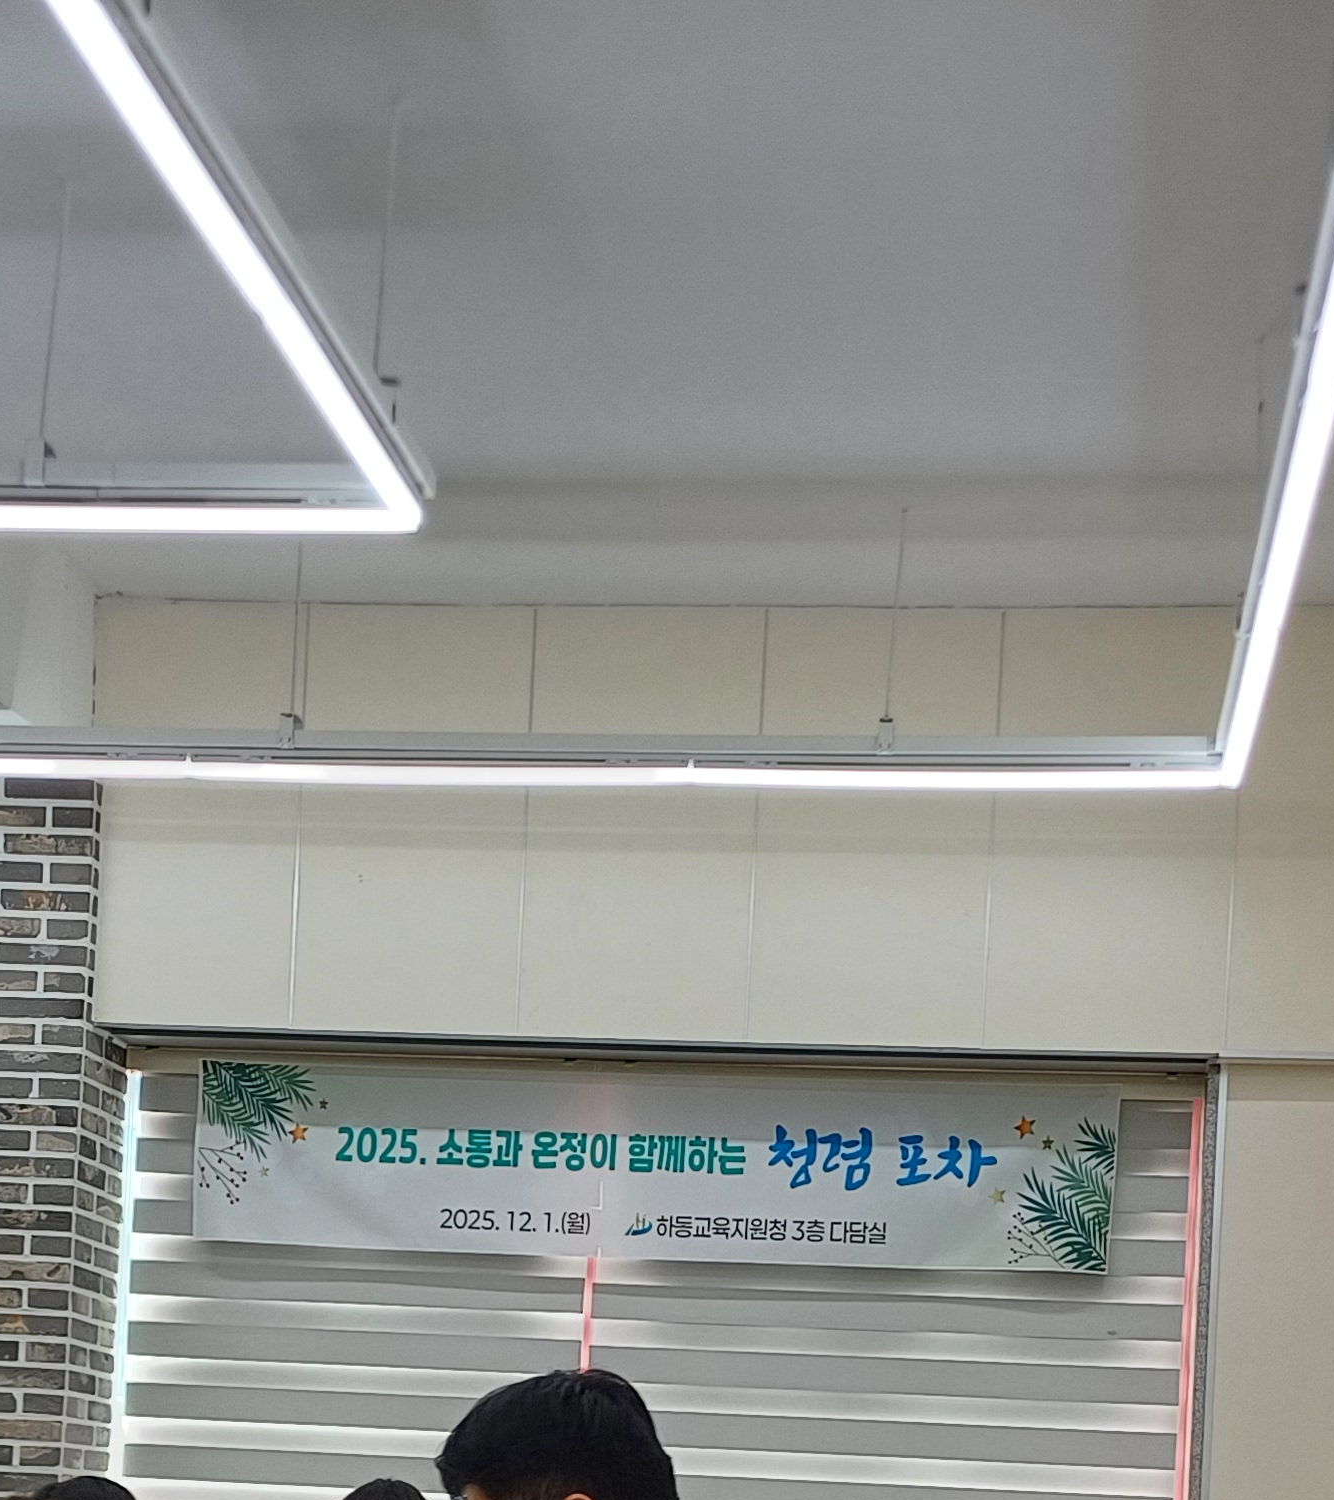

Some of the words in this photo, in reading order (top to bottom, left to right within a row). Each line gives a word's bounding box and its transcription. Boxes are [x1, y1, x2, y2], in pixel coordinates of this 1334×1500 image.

[335, 1126, 427, 1165] 2025.
[436, 1127, 524, 1169] 소통과
[531, 1130, 617, 1172] 온정이
[628, 1133, 746, 1176] 함께하는
[768, 1124, 874, 1191] 청렴
[896, 1134, 999, 1188] 포차
[439, 1208, 501, 1232] 2025.
[655, 1214, 788, 1242] 하동교육지원청
[791, 1219, 826, 1243] 3층
[829, 1220, 887, 1245] 다담실
